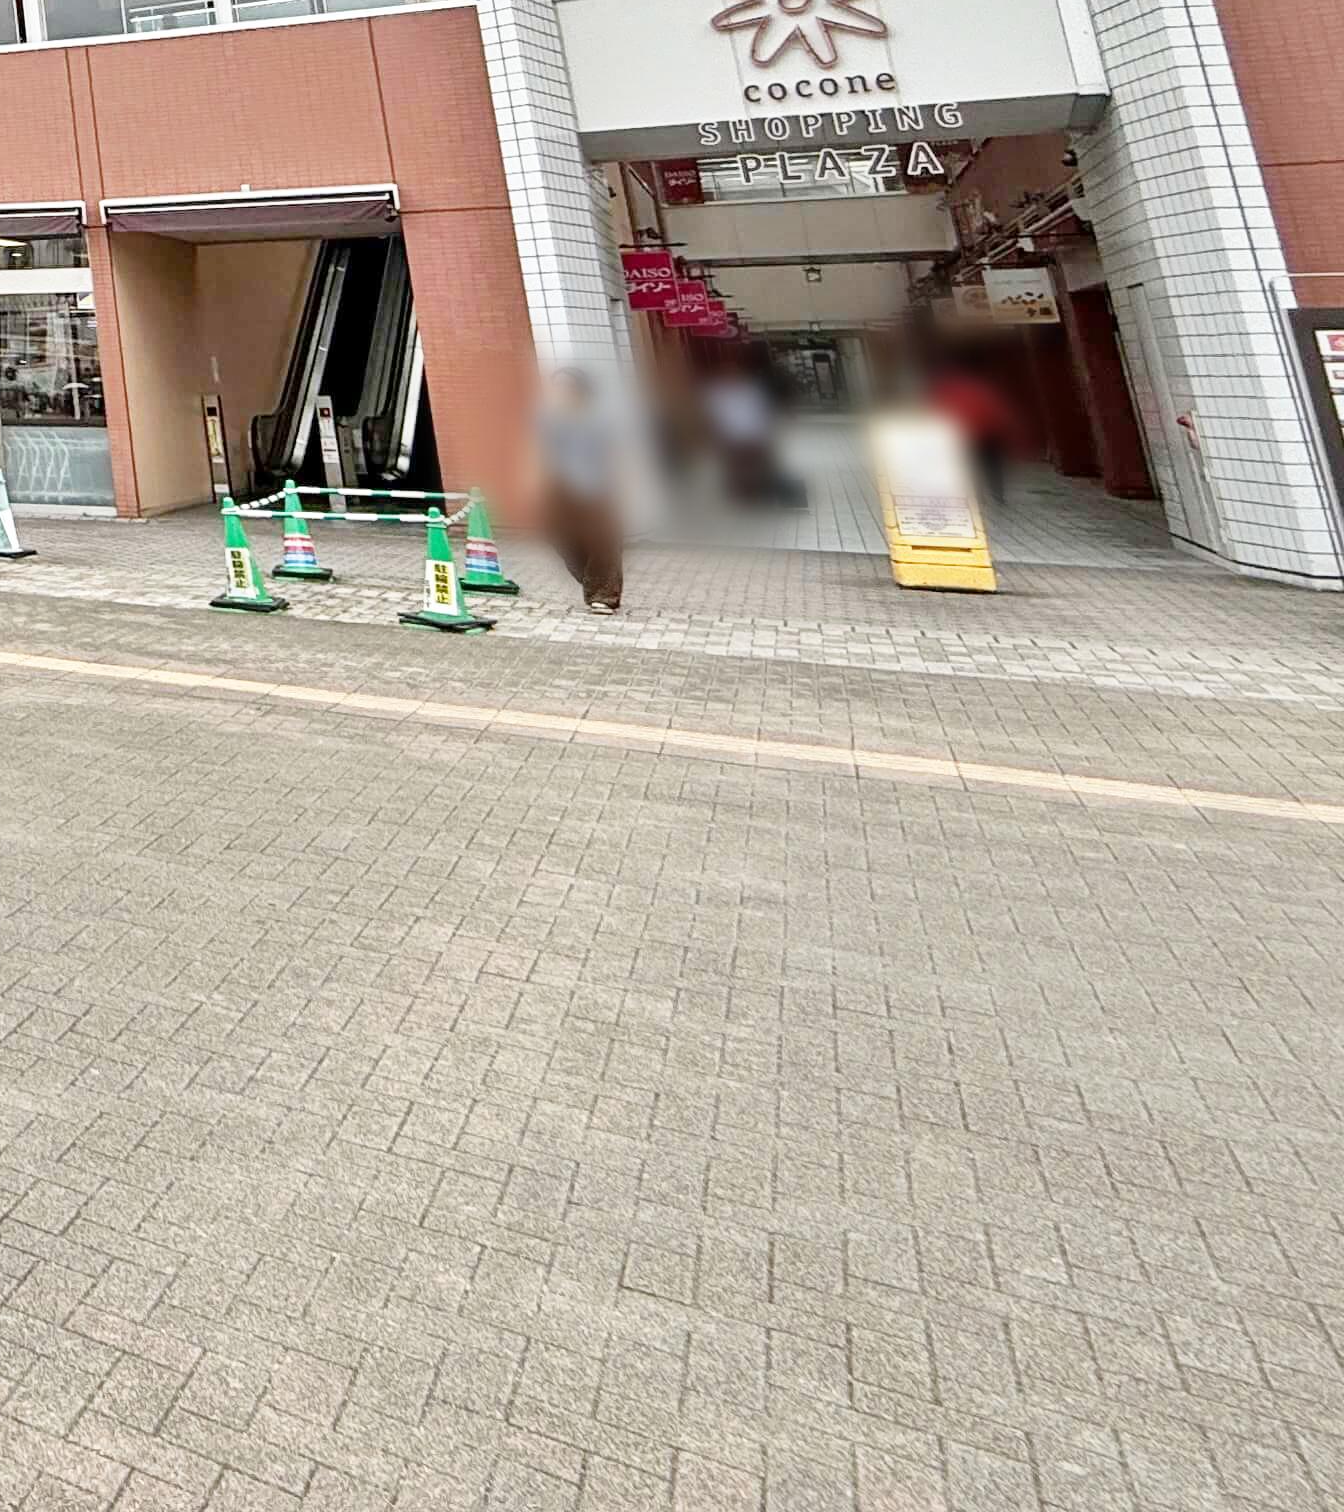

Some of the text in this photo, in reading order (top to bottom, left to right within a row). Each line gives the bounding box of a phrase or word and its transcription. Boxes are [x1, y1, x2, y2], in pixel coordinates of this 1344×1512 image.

[743, 72, 896, 103] cocone
[699, 102, 963, 145] SHOPPING
[738, 142, 945, 185] PLAZA
